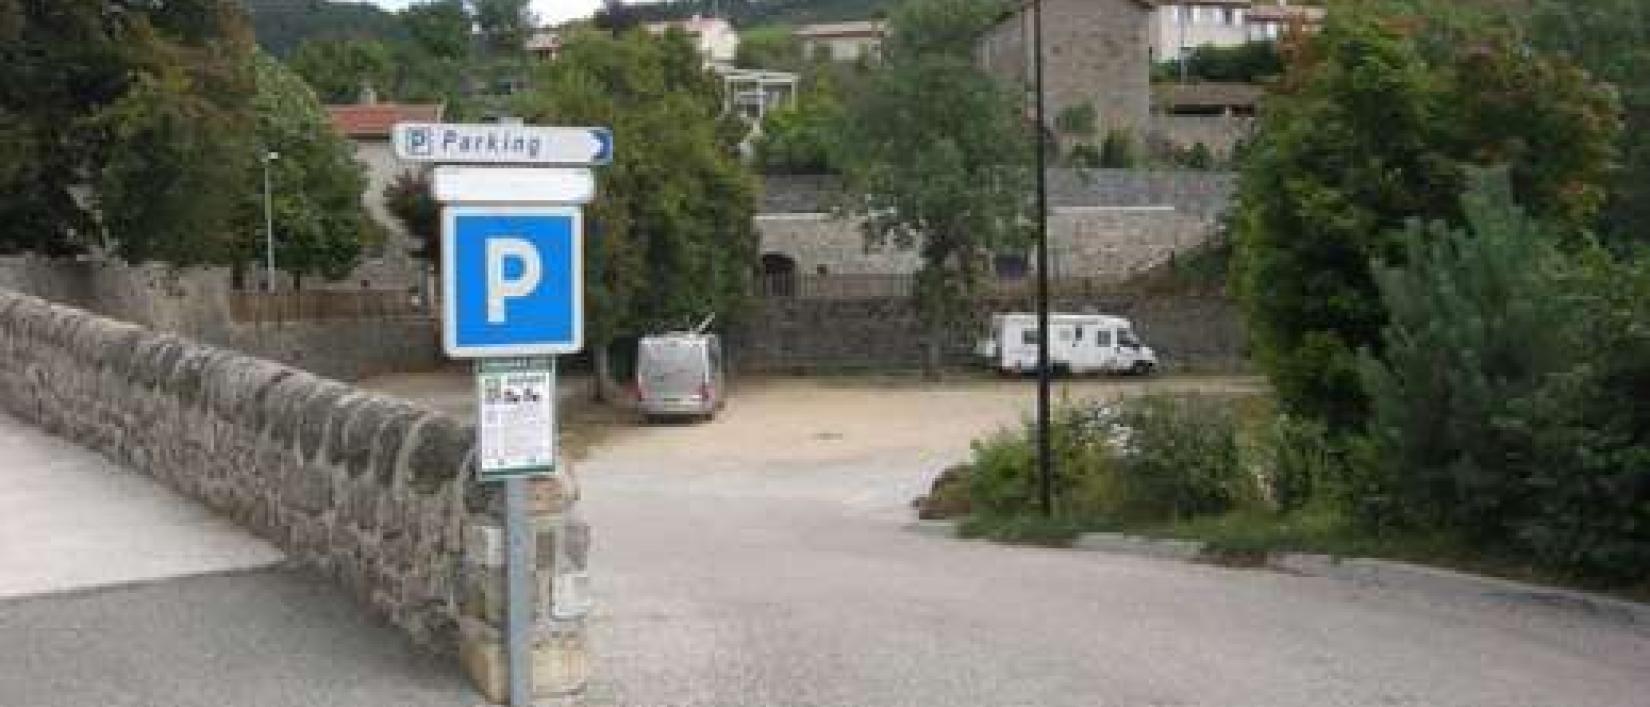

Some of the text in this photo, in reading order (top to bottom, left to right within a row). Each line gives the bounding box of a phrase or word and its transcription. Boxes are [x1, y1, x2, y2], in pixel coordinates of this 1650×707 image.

[411, 128, 542, 157] P Parking
[485, 238, 543, 324] P
